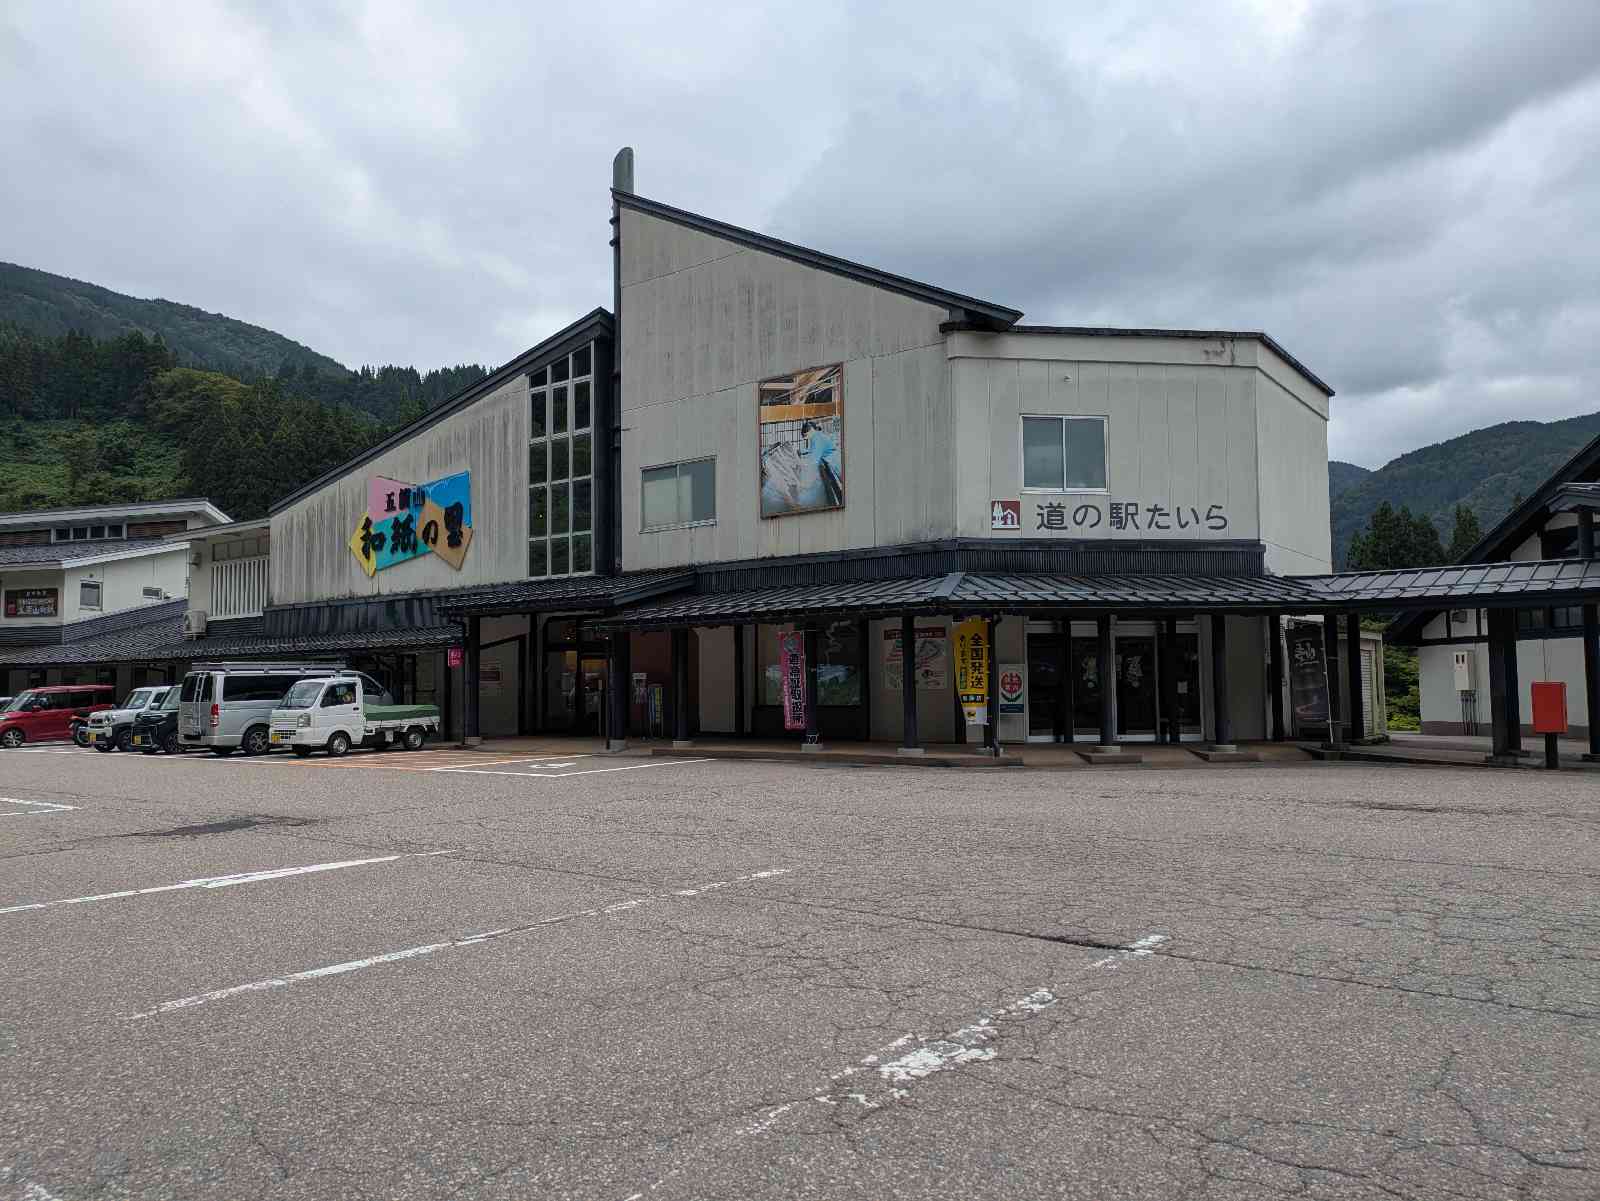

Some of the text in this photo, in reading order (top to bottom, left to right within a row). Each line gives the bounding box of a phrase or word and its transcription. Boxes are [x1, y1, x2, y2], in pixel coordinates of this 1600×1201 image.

[360, 502, 464, 560] 和紙の里
[1036, 502, 1228, 531] 道の駅たいら
[970, 633, 984, 689] 全国発送
